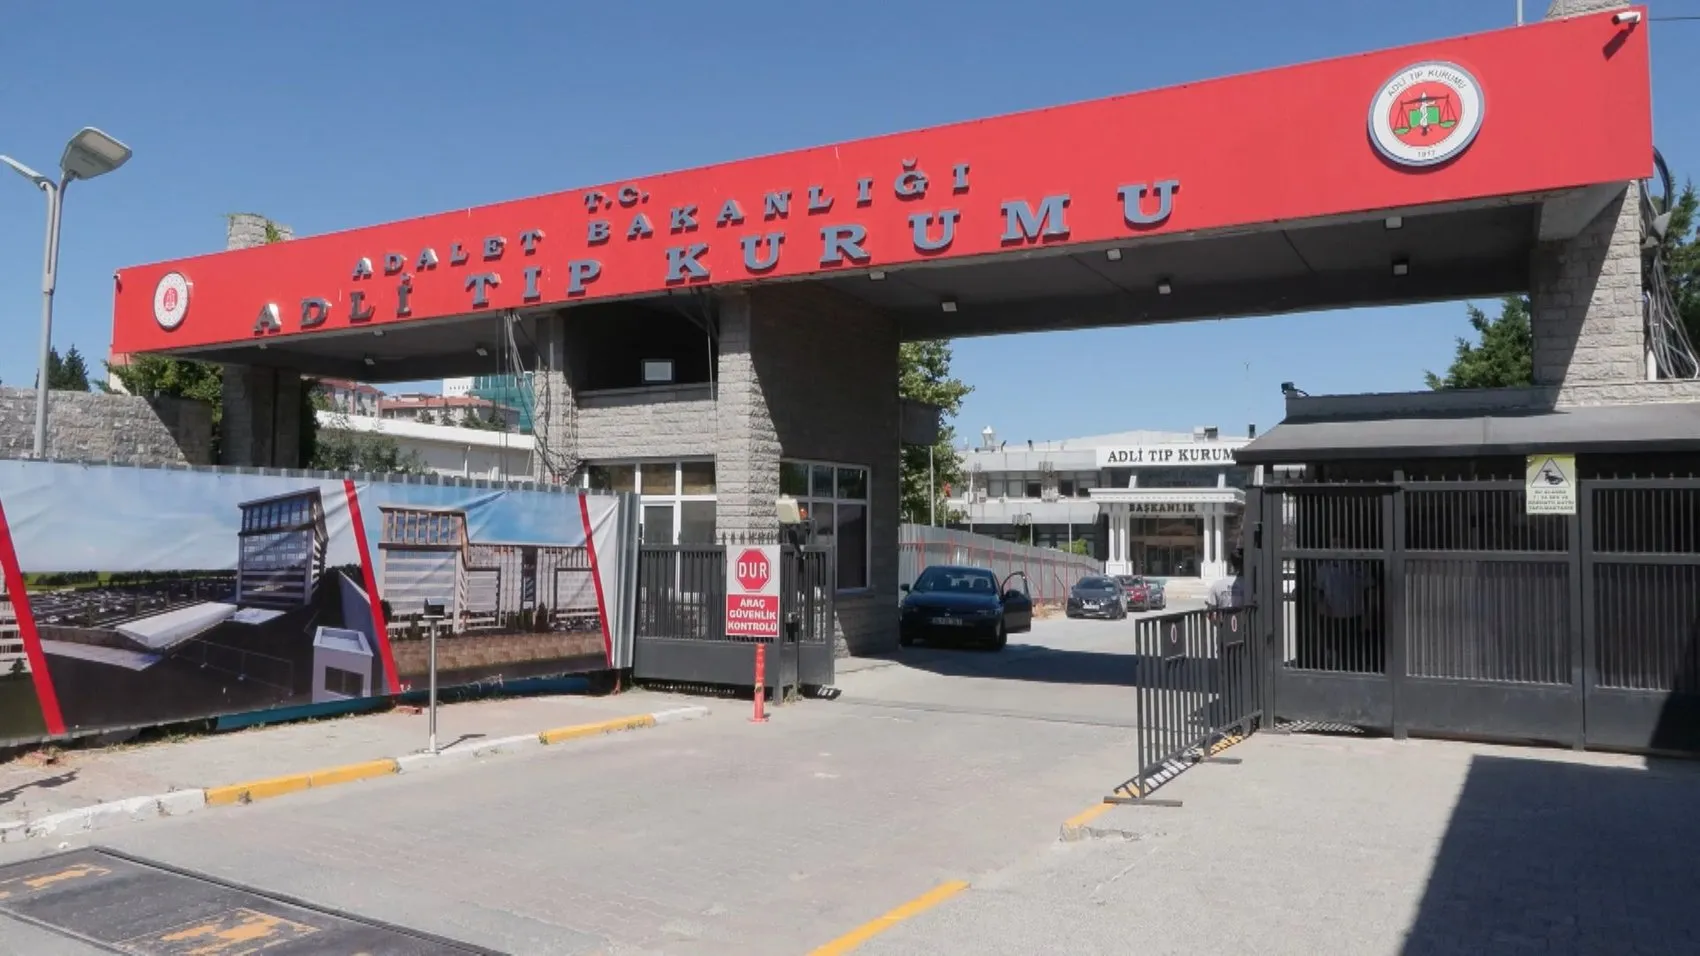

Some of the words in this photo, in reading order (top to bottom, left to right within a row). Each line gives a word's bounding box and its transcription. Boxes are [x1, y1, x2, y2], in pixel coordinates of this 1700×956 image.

[585, 184, 649, 210] T.C.
[352, 229, 544, 280] ADALET
[587, 158, 969, 245] BAKANLIĞI
[254, 271, 415, 336] ADLİ
[466, 259, 602, 310] TIP
[665, 179, 1179, 284] KURUMU
[1108, 448, 1143, 463] ADLİ
[1148, 448, 1173, 462] TIP
[1129, 503, 1196, 513] BAŞKANLIK
[739, 562, 767, 578] DUR
[740, 598, 765, 609] ARAÇ
[729, 610, 776, 620] GÜVENLİK
[728, 622, 776, 632] KONTROLÜ
